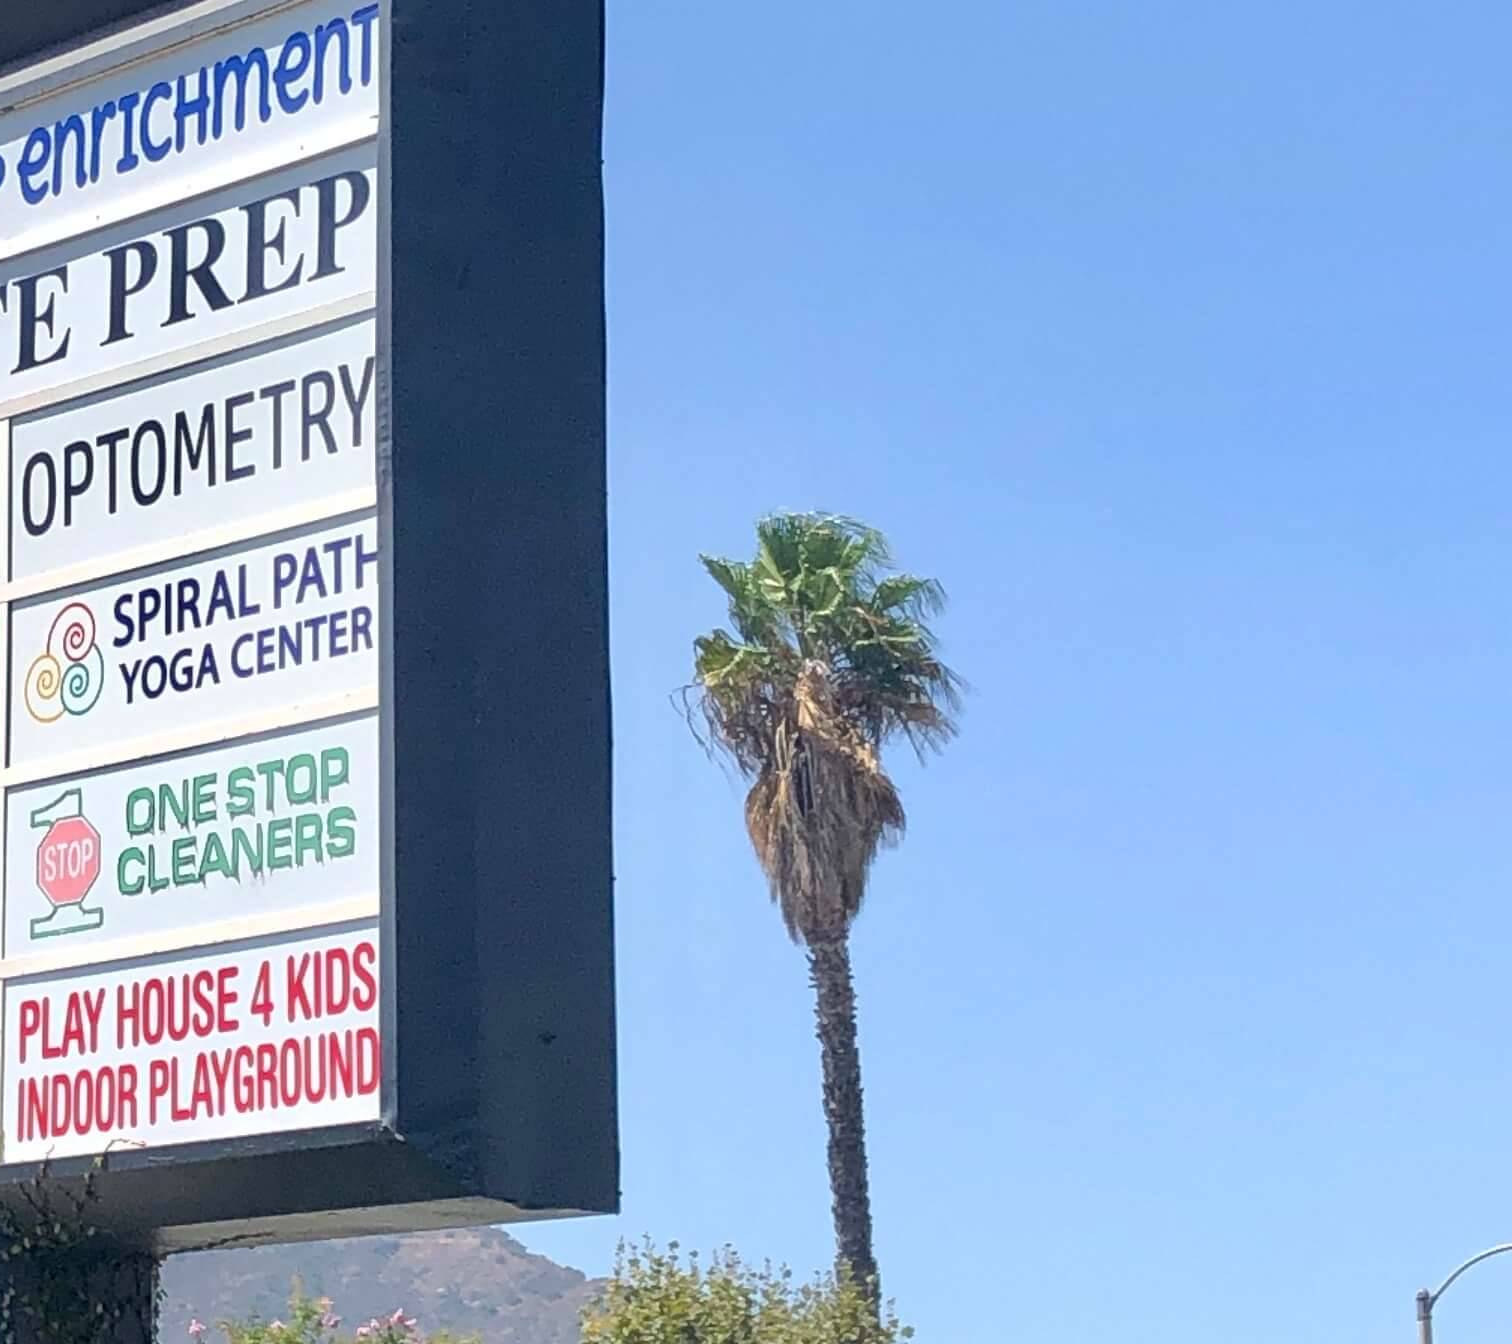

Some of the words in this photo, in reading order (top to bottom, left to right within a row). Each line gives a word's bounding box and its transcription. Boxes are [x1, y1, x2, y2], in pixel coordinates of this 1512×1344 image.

[100, 169, 371, 346] PREP
[21, 356, 375, 536] OPTOMETRY
[112, 563, 260, 648] SPIRAL
[119, 642, 220, 705] YOGA
[231, 606, 374, 679] CENTER
[126, 772, 218, 836] ONE
[225, 746, 350, 817] STOP
[44, 838, 94, 882] STOP
[116, 806, 358, 896] CLEANERS
[19, 987, 107, 1064] PLAY
[116, 966, 239, 1050] HOUSE
[250, 960, 275, 1026] 4
[287, 942, 378, 1023] KIDS
[17, 1063, 138, 1143] INDOOR
[149, 1026, 382, 1126] PLAYGROUND
